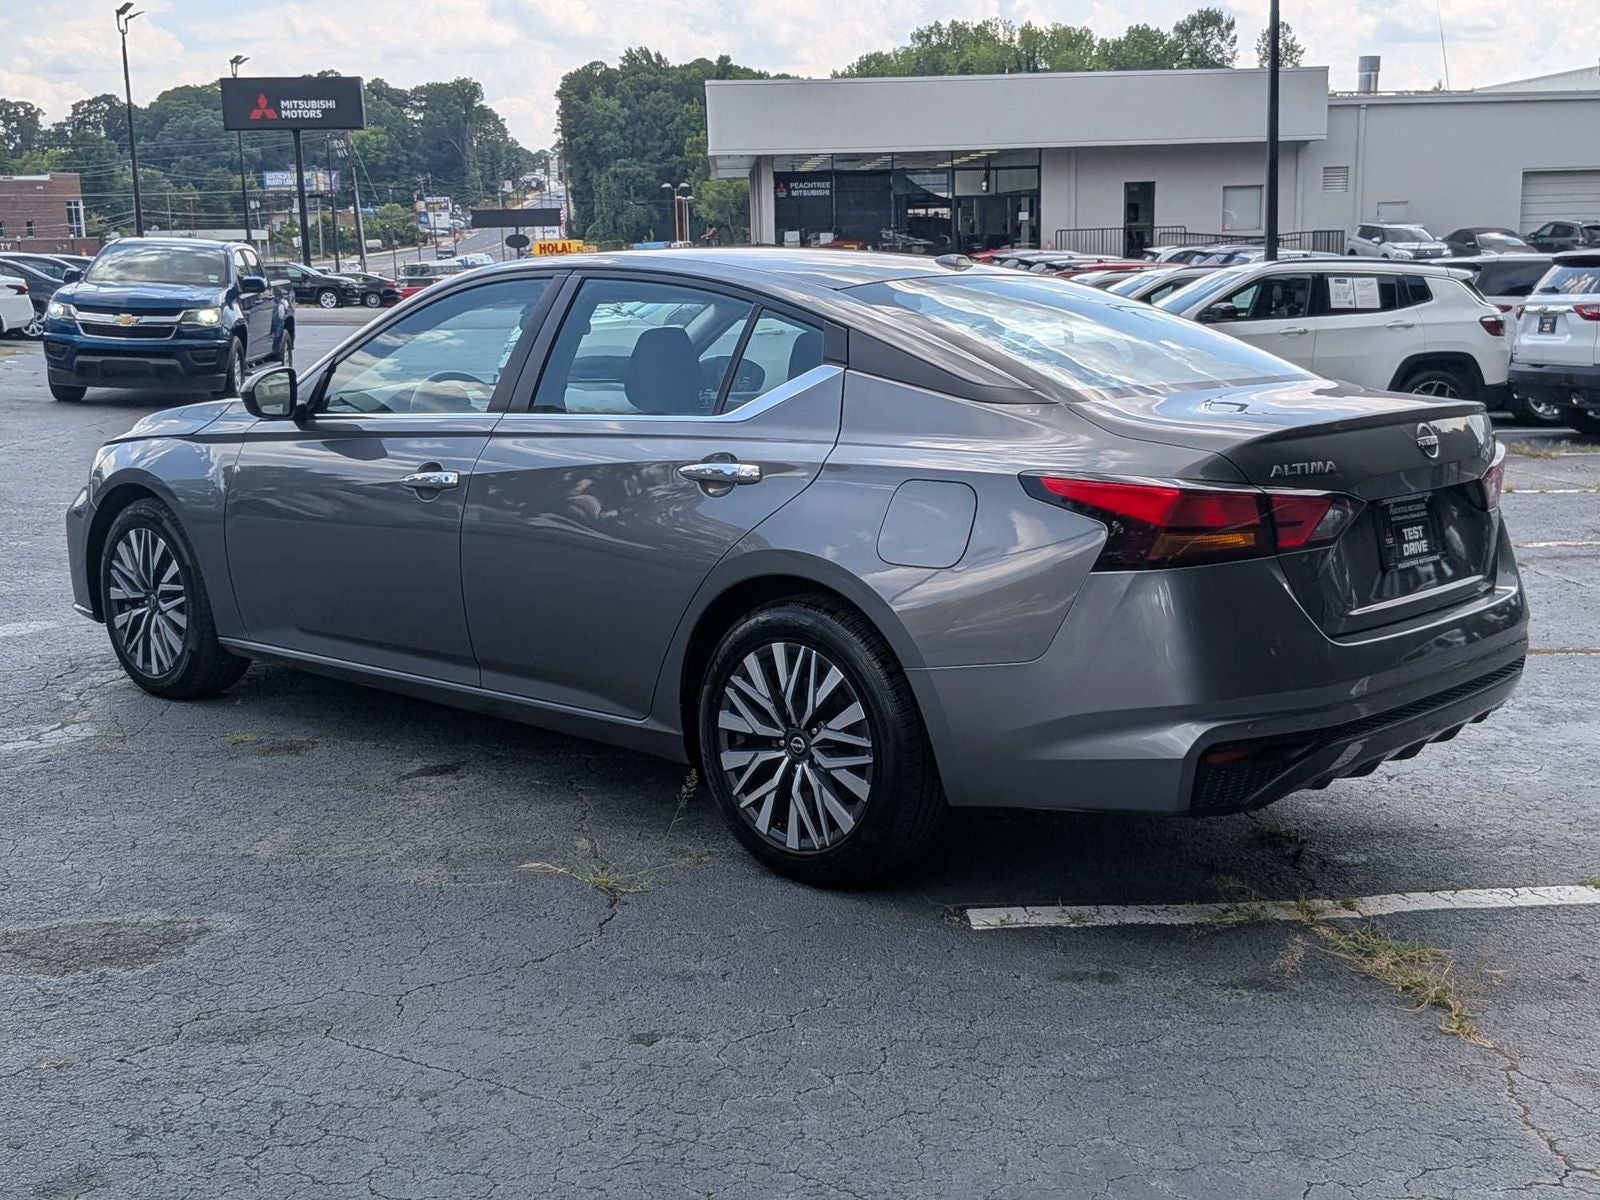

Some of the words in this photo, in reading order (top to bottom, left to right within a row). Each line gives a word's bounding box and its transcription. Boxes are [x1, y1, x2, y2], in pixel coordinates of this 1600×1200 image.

[280, 100, 336, 109] MITSUBISHI
[281, 110, 323, 119] MOTORS
[790, 181, 831, 189] PEACHTREE
[791, 189, 830, 197] MITSUBISHI
[539, 242, 572, 254] HOLA!
[1270, 460, 1337, 478] ALTIMA
[1402, 525, 1424, 541] TEST
[1402, 540, 1428, 556] DRIVE
